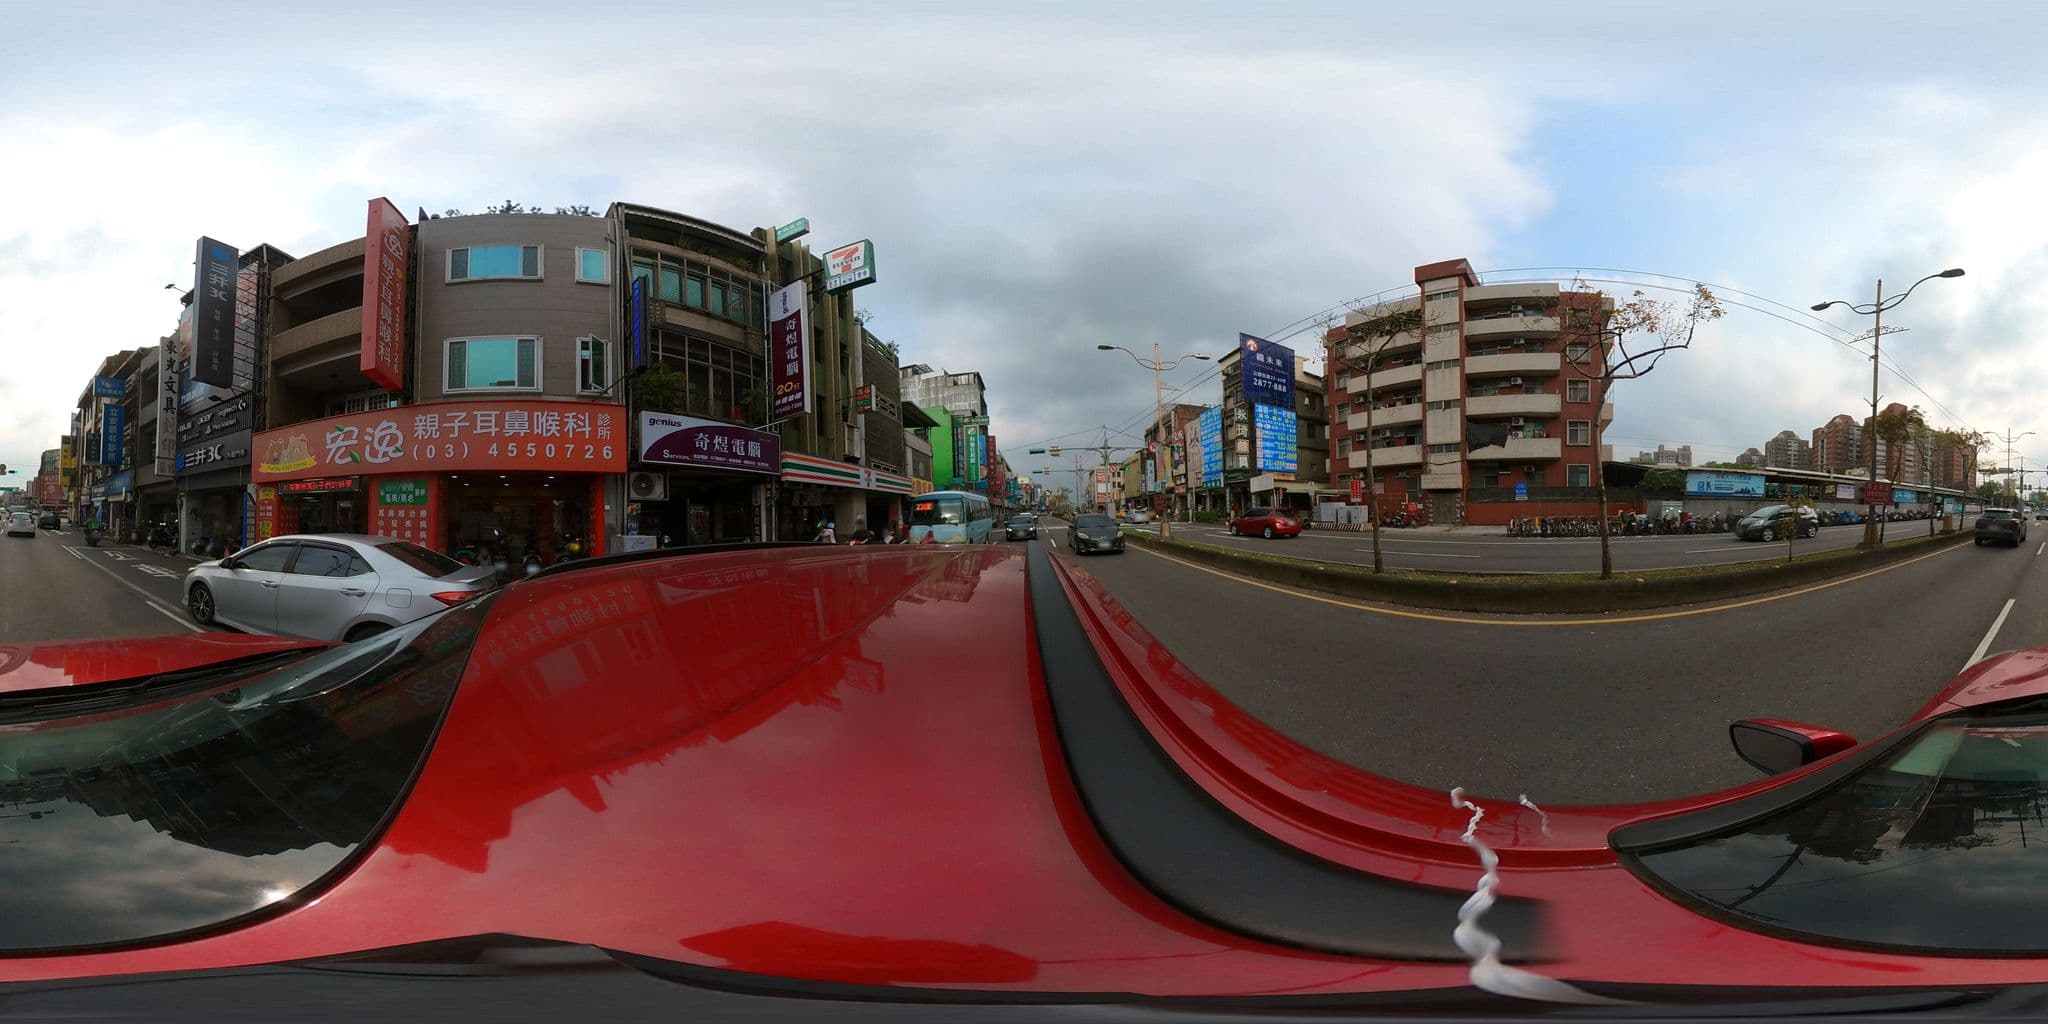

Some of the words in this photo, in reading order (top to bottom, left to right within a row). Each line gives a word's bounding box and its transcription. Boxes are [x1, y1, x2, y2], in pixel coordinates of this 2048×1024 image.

[413, 409, 591, 440] 親子耳鼻喉科
[597, 412, 612, 441] 診所
[648, 417, 682, 428] genius
[413, 443, 470, 460] (03)
[488, 443, 614, 460] 4550726
[694, 432, 762, 458] 奇煜電腦
